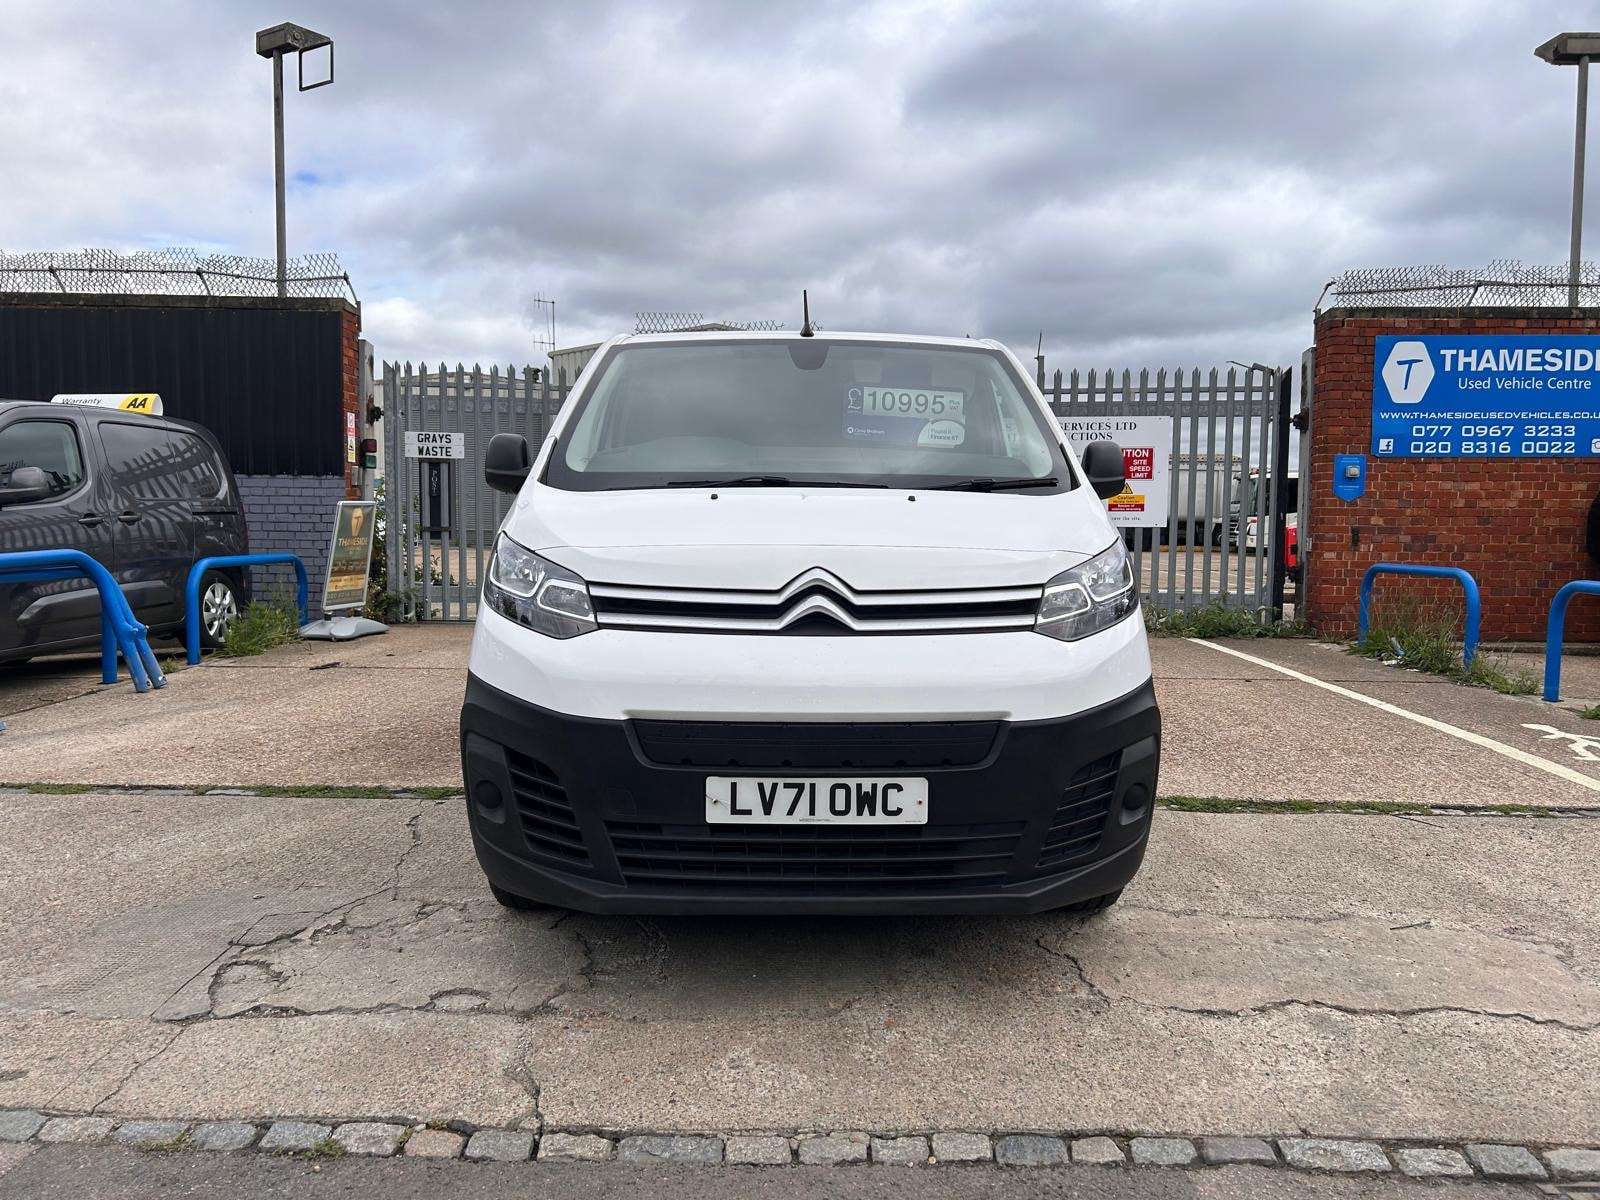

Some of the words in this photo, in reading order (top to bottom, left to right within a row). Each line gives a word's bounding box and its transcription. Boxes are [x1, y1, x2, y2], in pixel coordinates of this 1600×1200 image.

[1458, 377, 1491, 390] Used
[1496, 377, 1543, 390] Vehicle
[1547, 377, 1592, 390] Centre
[62, 397, 102, 405] Warranty
[126, 397, 148, 409] AA
[867, 390, 945, 415] 10995
[1116, 421, 1137, 431] LTD
[1412, 425, 1452, 437] 077
[1461, 425, 1514, 437] 0967
[1524, 425, 1576, 437] 3233
[417, 433, 452, 444] GRAYS
[417, 446, 452, 457] WASTE
[1410, 441, 1451, 454] 020
[1461, 441, 1511, 454] 8316
[1521, 441, 1576, 454] 0022
[730, 781, 816, 816] LV71
[828, 782, 904, 817] OWC
